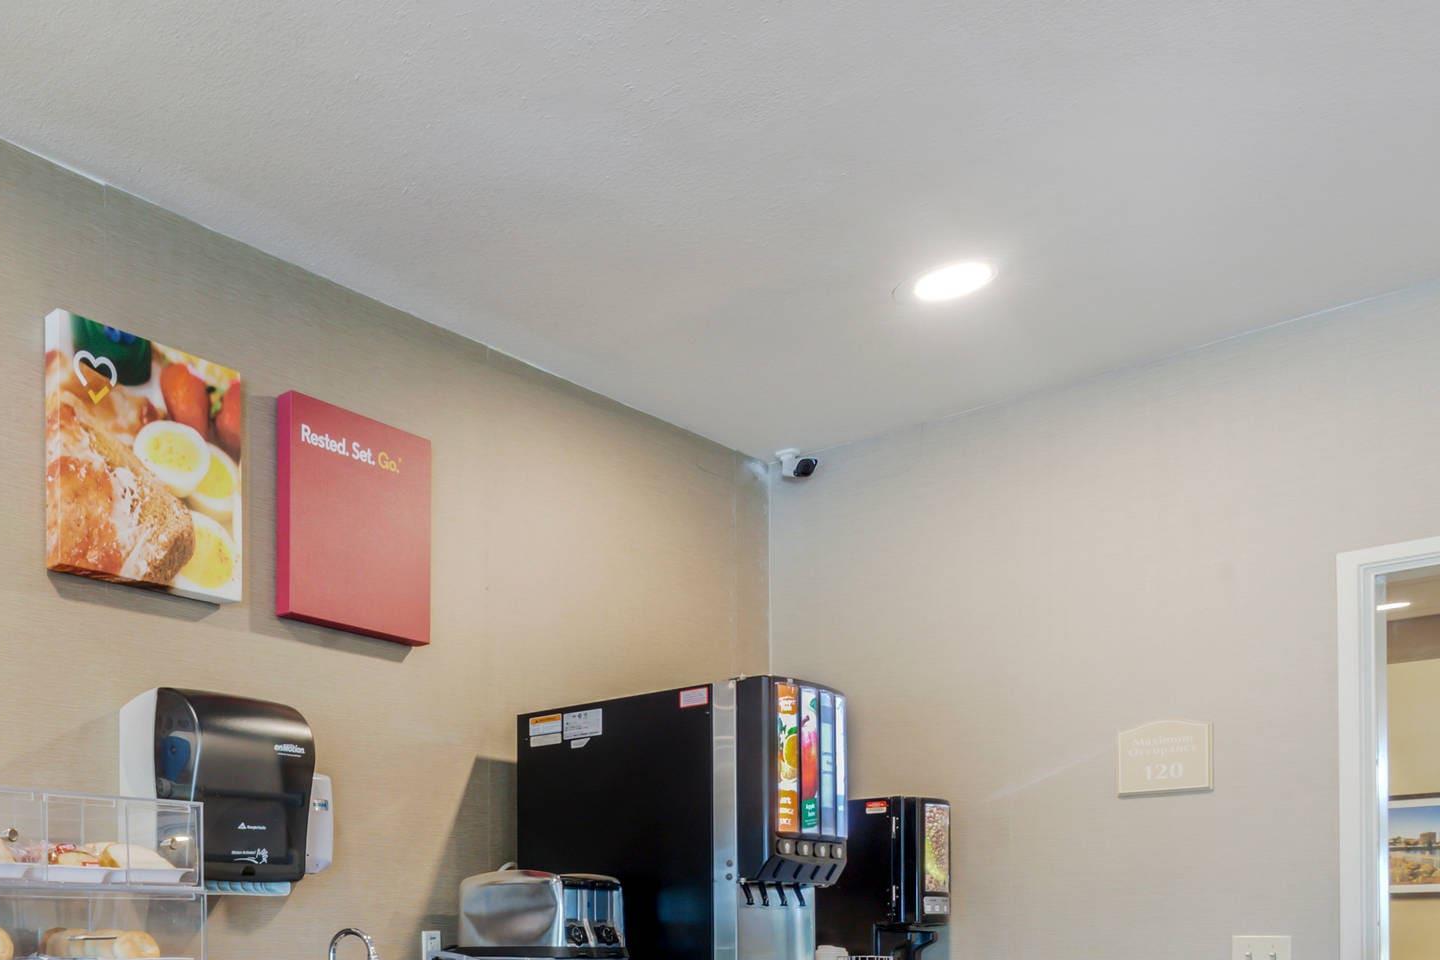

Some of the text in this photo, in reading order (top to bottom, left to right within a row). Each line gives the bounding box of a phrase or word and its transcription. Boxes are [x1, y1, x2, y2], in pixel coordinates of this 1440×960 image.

[301, 423, 349, 456] Rested.
[351, 441, 375, 466] Set.
[1145, 762, 1184, 781] 120
